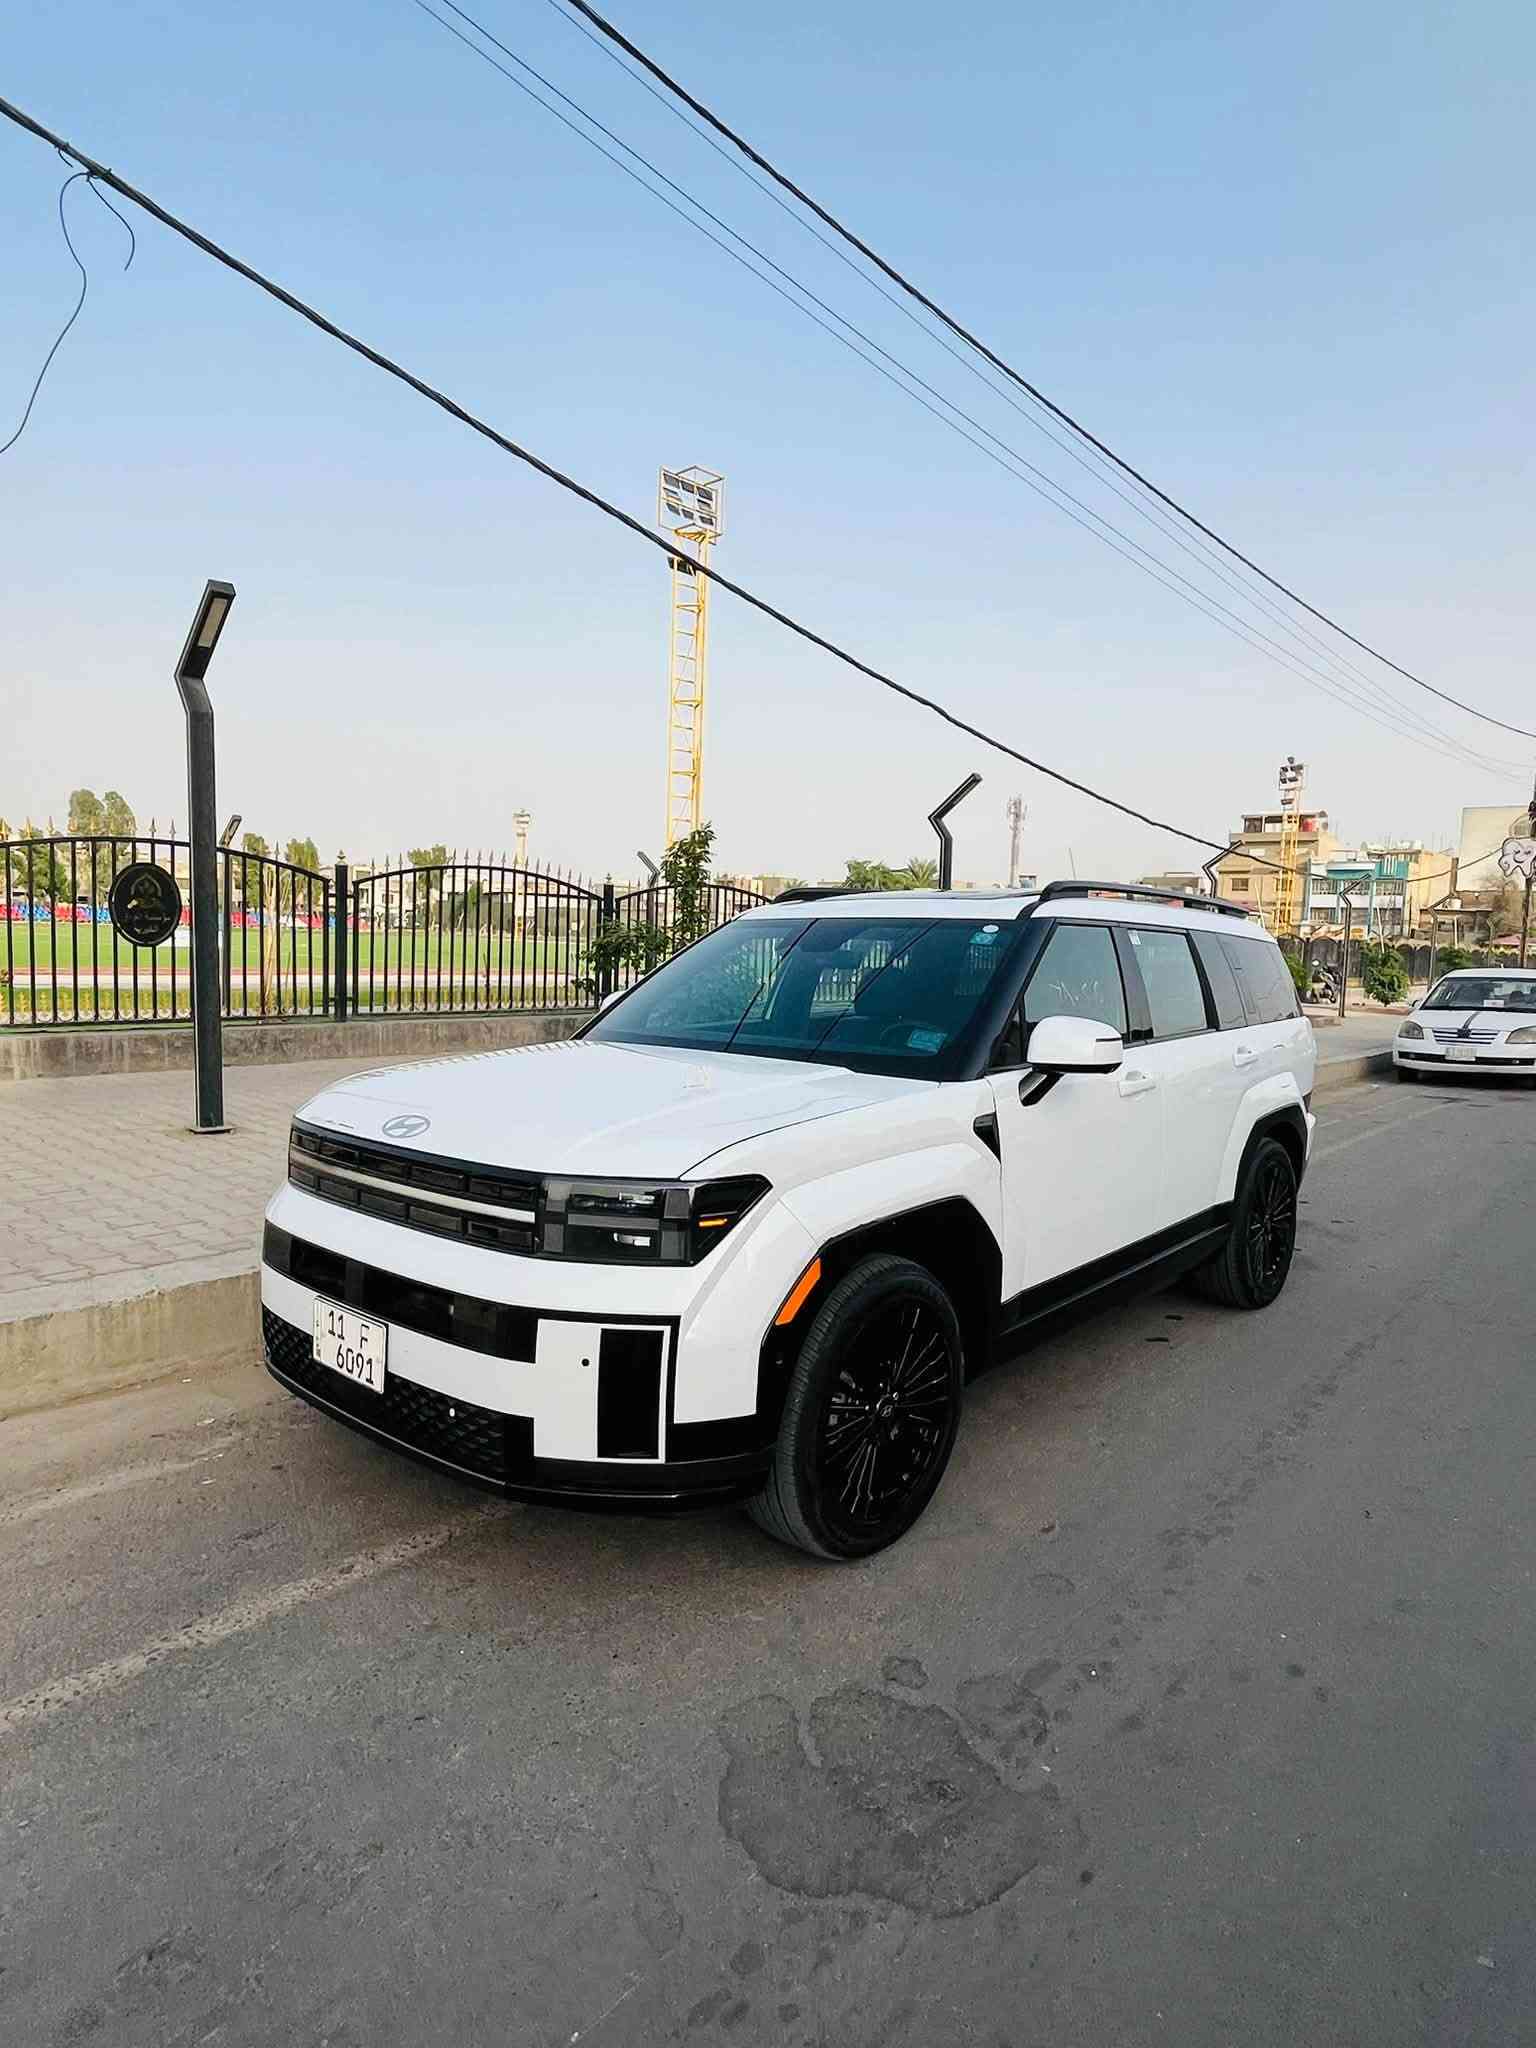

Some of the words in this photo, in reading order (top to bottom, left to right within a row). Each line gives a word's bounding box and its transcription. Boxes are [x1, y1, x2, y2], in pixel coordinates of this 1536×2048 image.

[327, 1310, 345, 1341] 11
[360, 1323, 370, 1349] F
[336, 1343, 375, 1385] 6091
